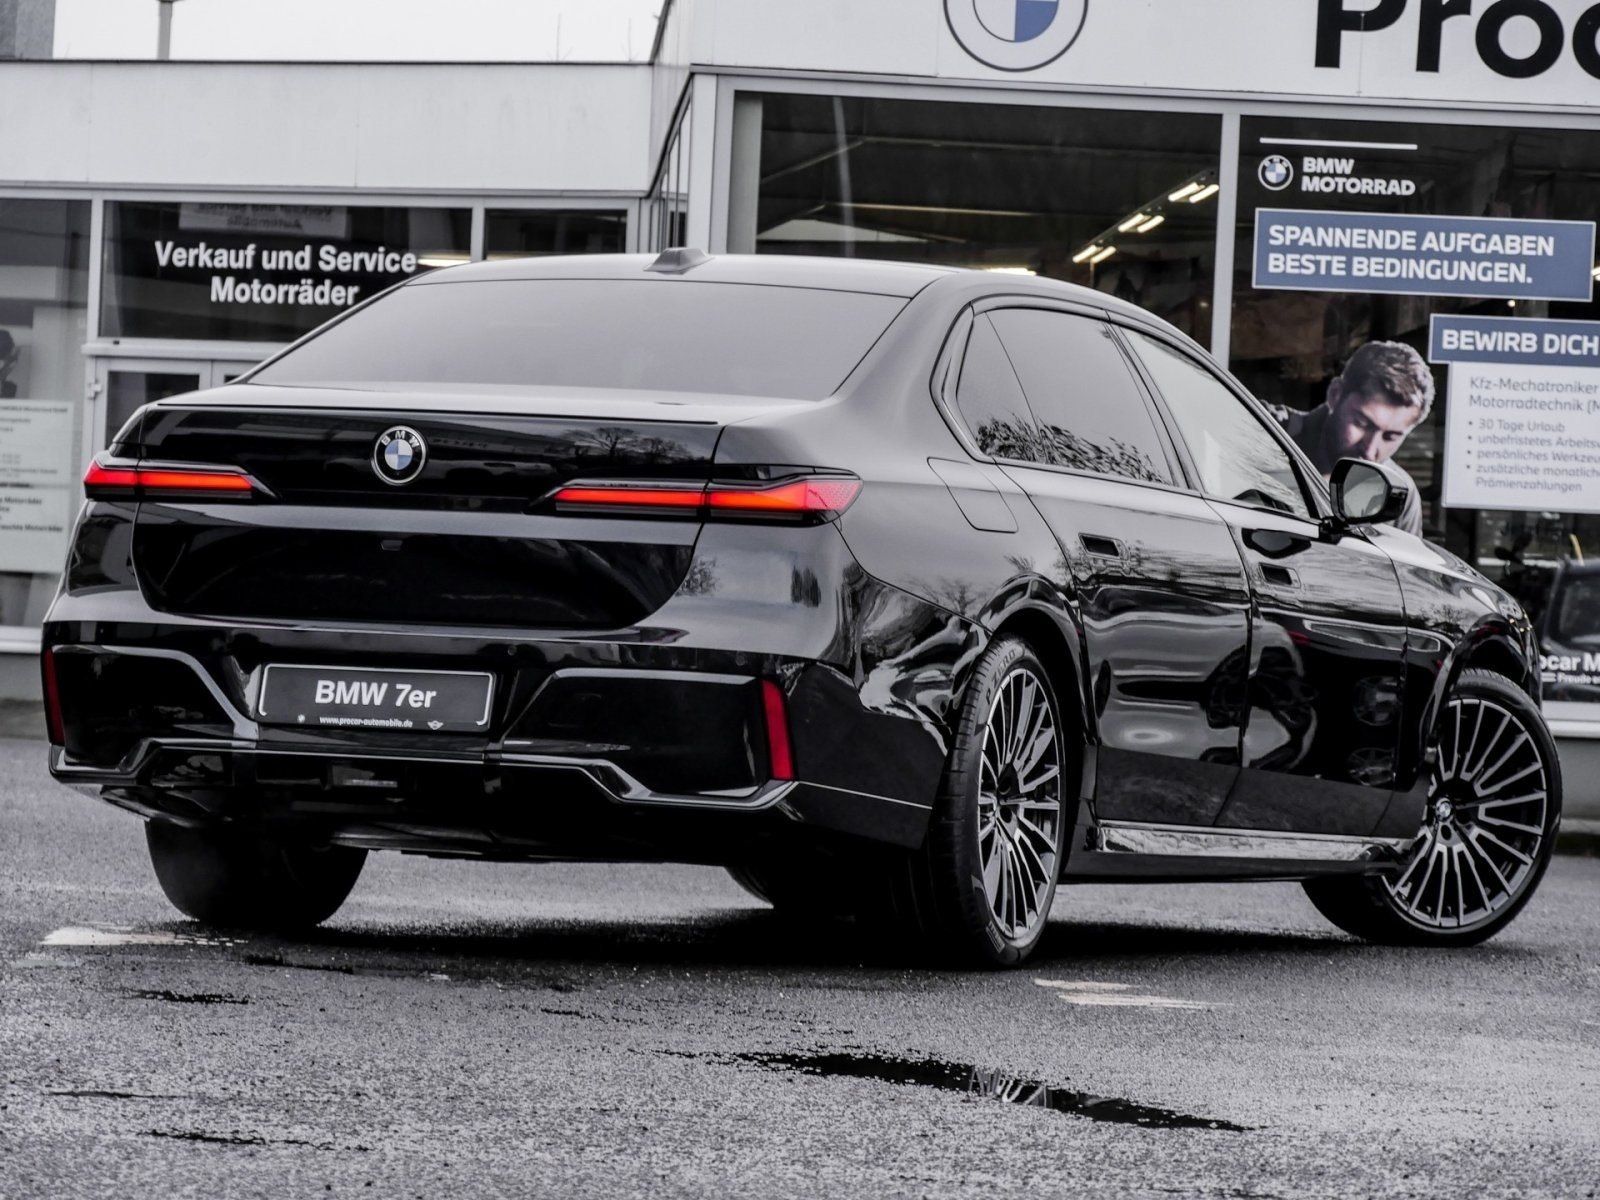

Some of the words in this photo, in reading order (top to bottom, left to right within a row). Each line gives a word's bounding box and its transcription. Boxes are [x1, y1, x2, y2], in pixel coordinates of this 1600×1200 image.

[1302, 156, 1354, 175] BMW
[1301, 175, 1416, 196] MOTORRAD
[1268, 224, 1417, 251] SPANNENDE
[1421, 231, 1555, 256] AUFGABEN
[154, 241, 256, 269] Verkauf
[261, 245, 311, 271] und
[318, 245, 417, 273] Service
[1267, 253, 1347, 276] BESTE
[1351, 256, 1533, 284] BEDINGUNGEN.
[210, 276, 359, 306] Motorräder
[1441, 329, 1538, 353] BEWIRB
[1543, 333, 1599, 356] DICH
[1470, 376, 1598, 394] Kfz-Mechatroniker
[1469, 394, 1583, 411] Motorradtechnik
[1479, 418, 1494, 430] 30
[1497, 419, 1524, 433] Tage
[1527, 421, 1565, 433] Urlaub
[381, 430, 420, 448] BMW
[1478, 435, 1552, 447] unbefristetes
[1477, 449, 1549, 462] persönliches
[1477, 464, 1540, 475] zusätzliche
[1476, 477, 1583, 493] Prämienzahlungen
[314, 679, 388, 706] BMW
[395, 683, 437, 708] 7er
[319, 717, 413, 728] www.procar-automobile.de
